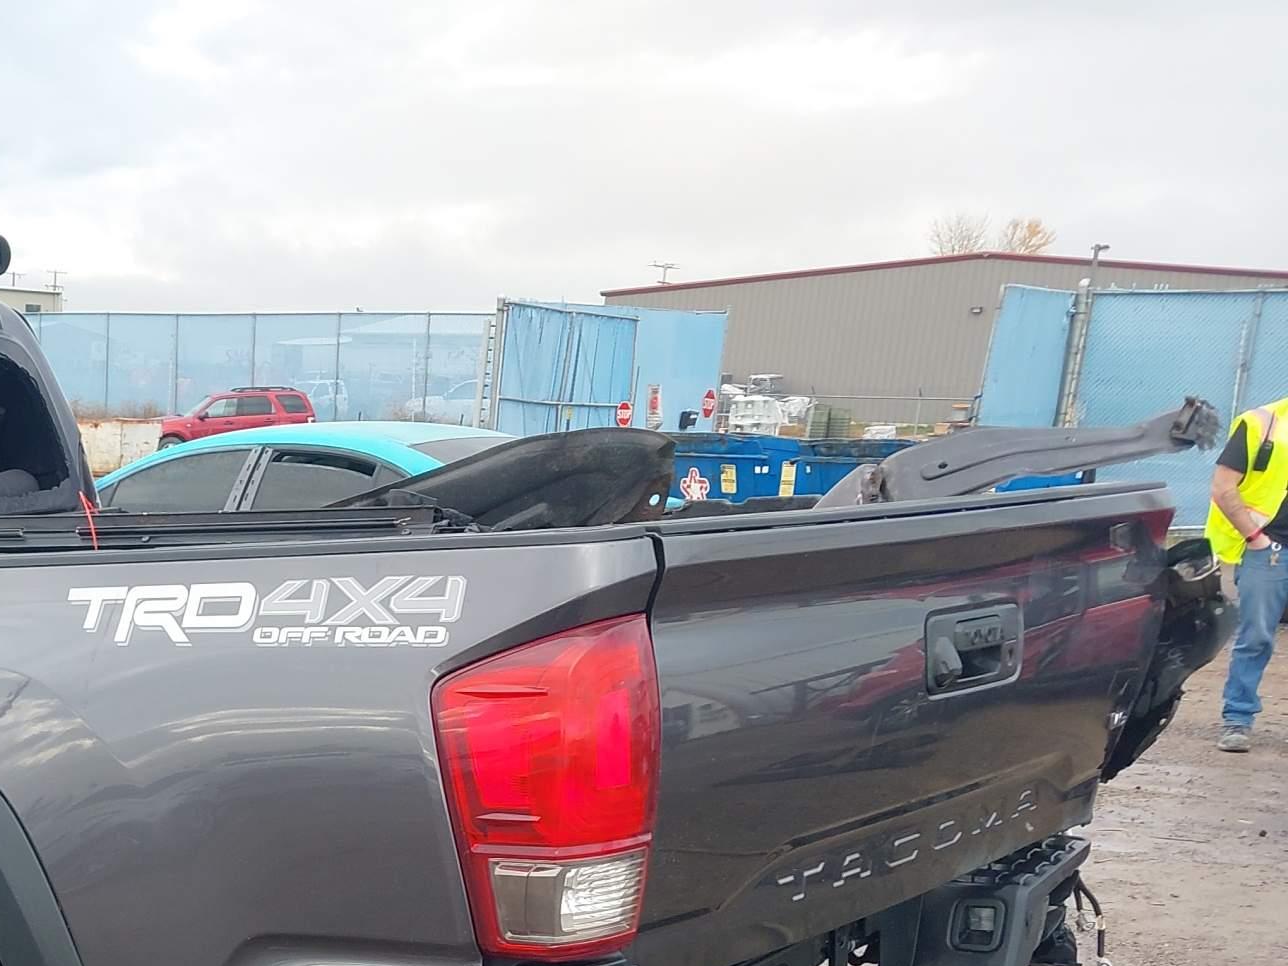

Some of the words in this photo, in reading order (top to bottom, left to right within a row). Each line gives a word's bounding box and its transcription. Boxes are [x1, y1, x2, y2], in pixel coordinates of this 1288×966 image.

[617, 409, 632, 420] STOP
[67, 581, 260, 647] TRD
[332, 625, 450, 648] ROAD
[776, 788, 1041, 903] TACOMA
